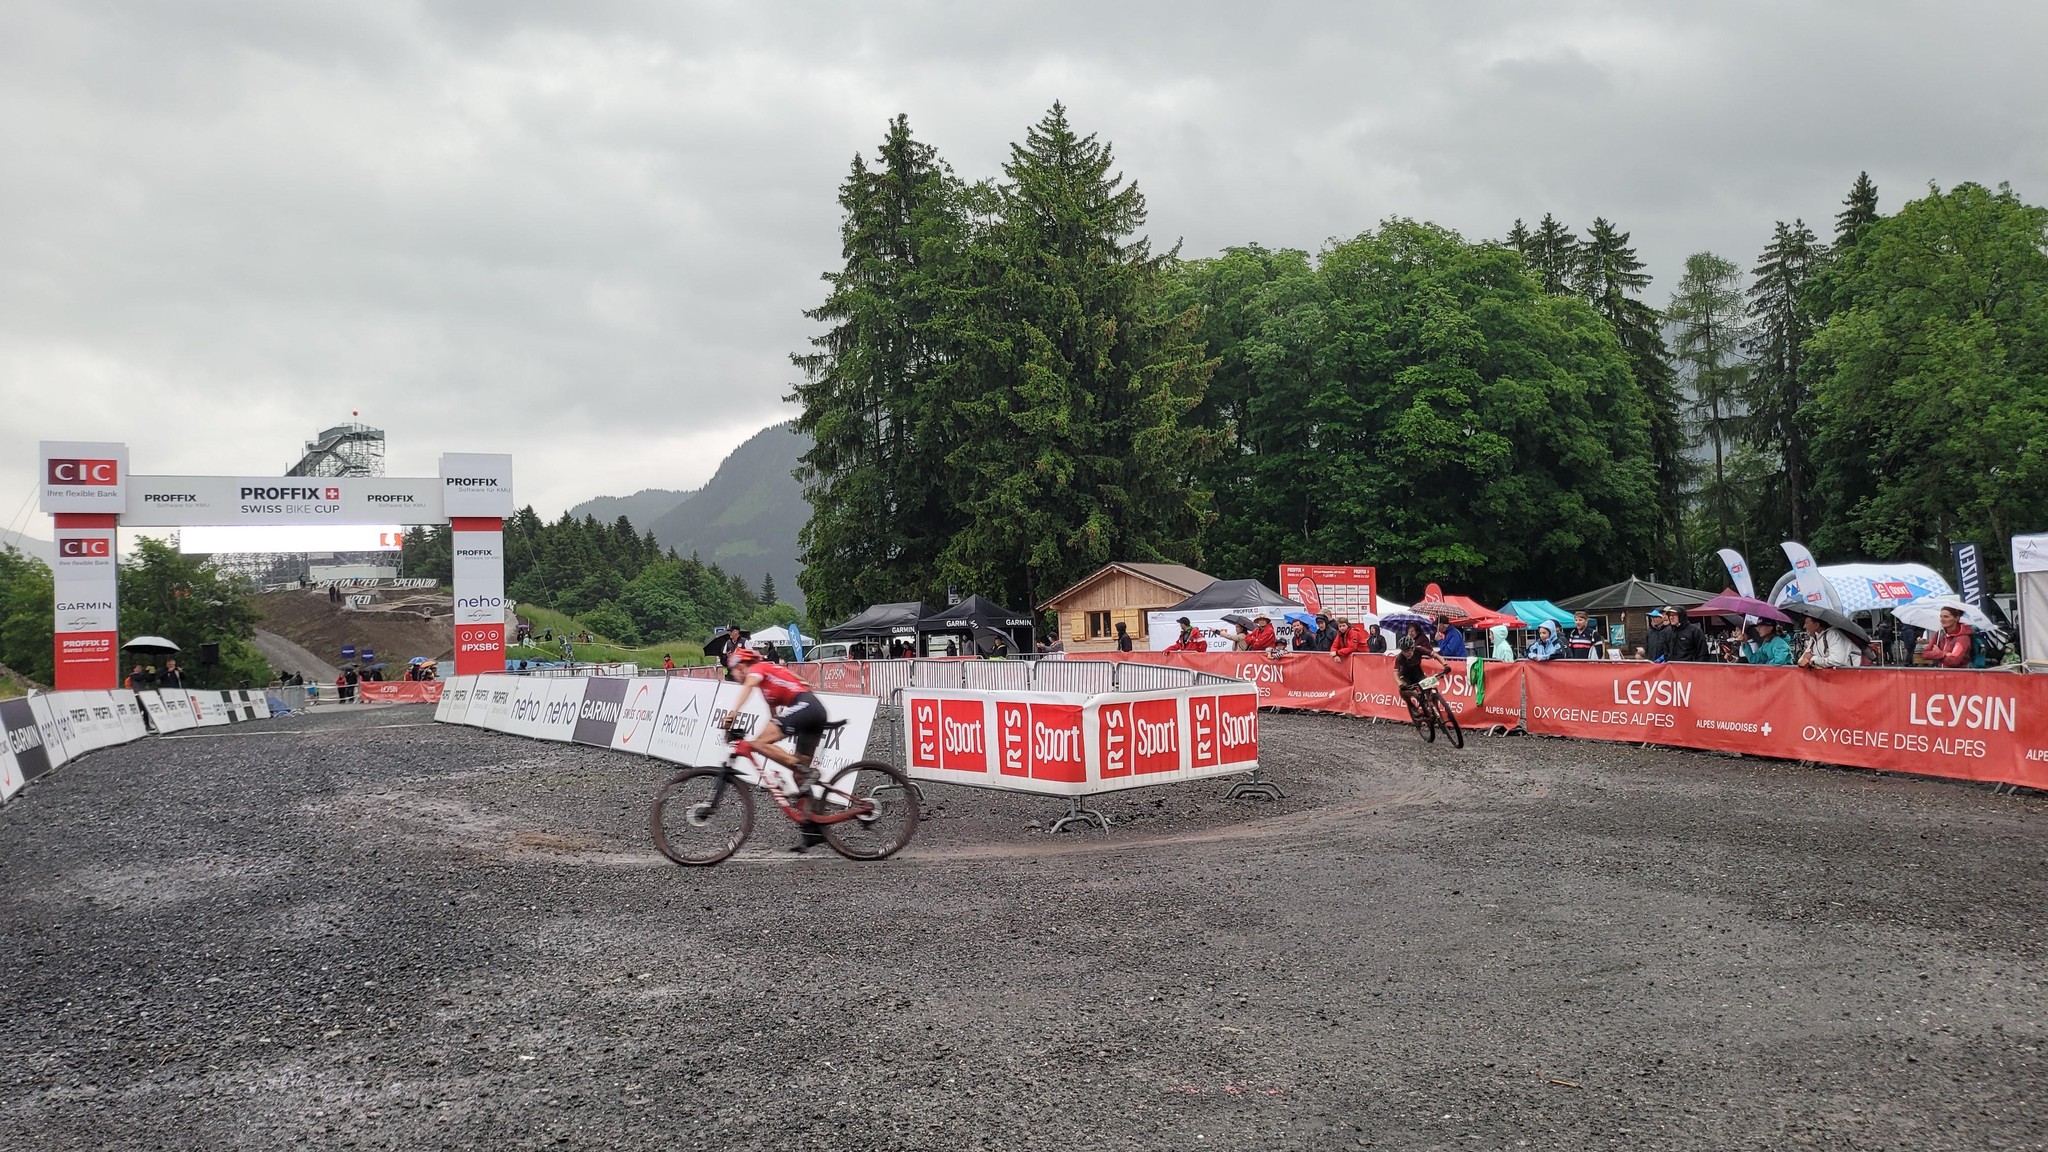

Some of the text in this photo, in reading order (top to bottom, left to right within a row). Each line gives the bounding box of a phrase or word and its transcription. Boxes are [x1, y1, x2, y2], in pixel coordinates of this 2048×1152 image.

[54, 463, 111, 481] CIC
[446, 477, 498, 487] PROFFIX
[65, 489, 95, 497] flexible
[97, 490, 118, 498] Bank
[144, 494, 197, 502] PROFFIX
[241, 487, 320, 500] PROFFIX
[367, 494, 415, 502] PROFFIX
[241, 505, 340, 514] SWISS BIKE CUP
[64, 542, 105, 554] CIC
[317, 578, 379, 589] SPECIALZED
[1875, 583, 1890, 598] RTS
[56, 602, 112, 611] GARMIN
[457, 595, 501, 607] neho
[892, 626, 915, 635] GARMIN
[1005, 619, 1032, 627] GARMIN
[461, 642, 500, 652] #PXSBC
[1236, 663, 1284, 683] LEYSIN
[1355, 691, 1407, 708] OXYGENE
[1614, 679, 1692, 708] LEYSIN
[511, 691, 541, 722] neho
[543, 693, 576, 725] neho
[580, 699, 621, 723] GARMIN
[622, 708, 636, 720] SWISS
[1485, 706, 1504, 715] ALPES
[1909, 692, 2016, 732] LEYSIN
[662, 714, 699, 738] PROTENT
[711, 708, 760, 736] PRFFIX
[1533, 705, 1758, 733] OXYGENE DES ALPES ALPES VAUDOISES
[8, 724, 42, 755] GARMIN
[918, 705, 983, 761] RTS Sport
[1005, 709, 1082, 769] RTS Sport
[1106, 709, 1176, 770] RTS Sport
[1196, 703, 1256, 760] RTS Sport
[1802, 725, 1889, 749] OXYGENE
[1893, 733, 1929, 752] DES
[1932, 736, 1986, 758] ALPES
